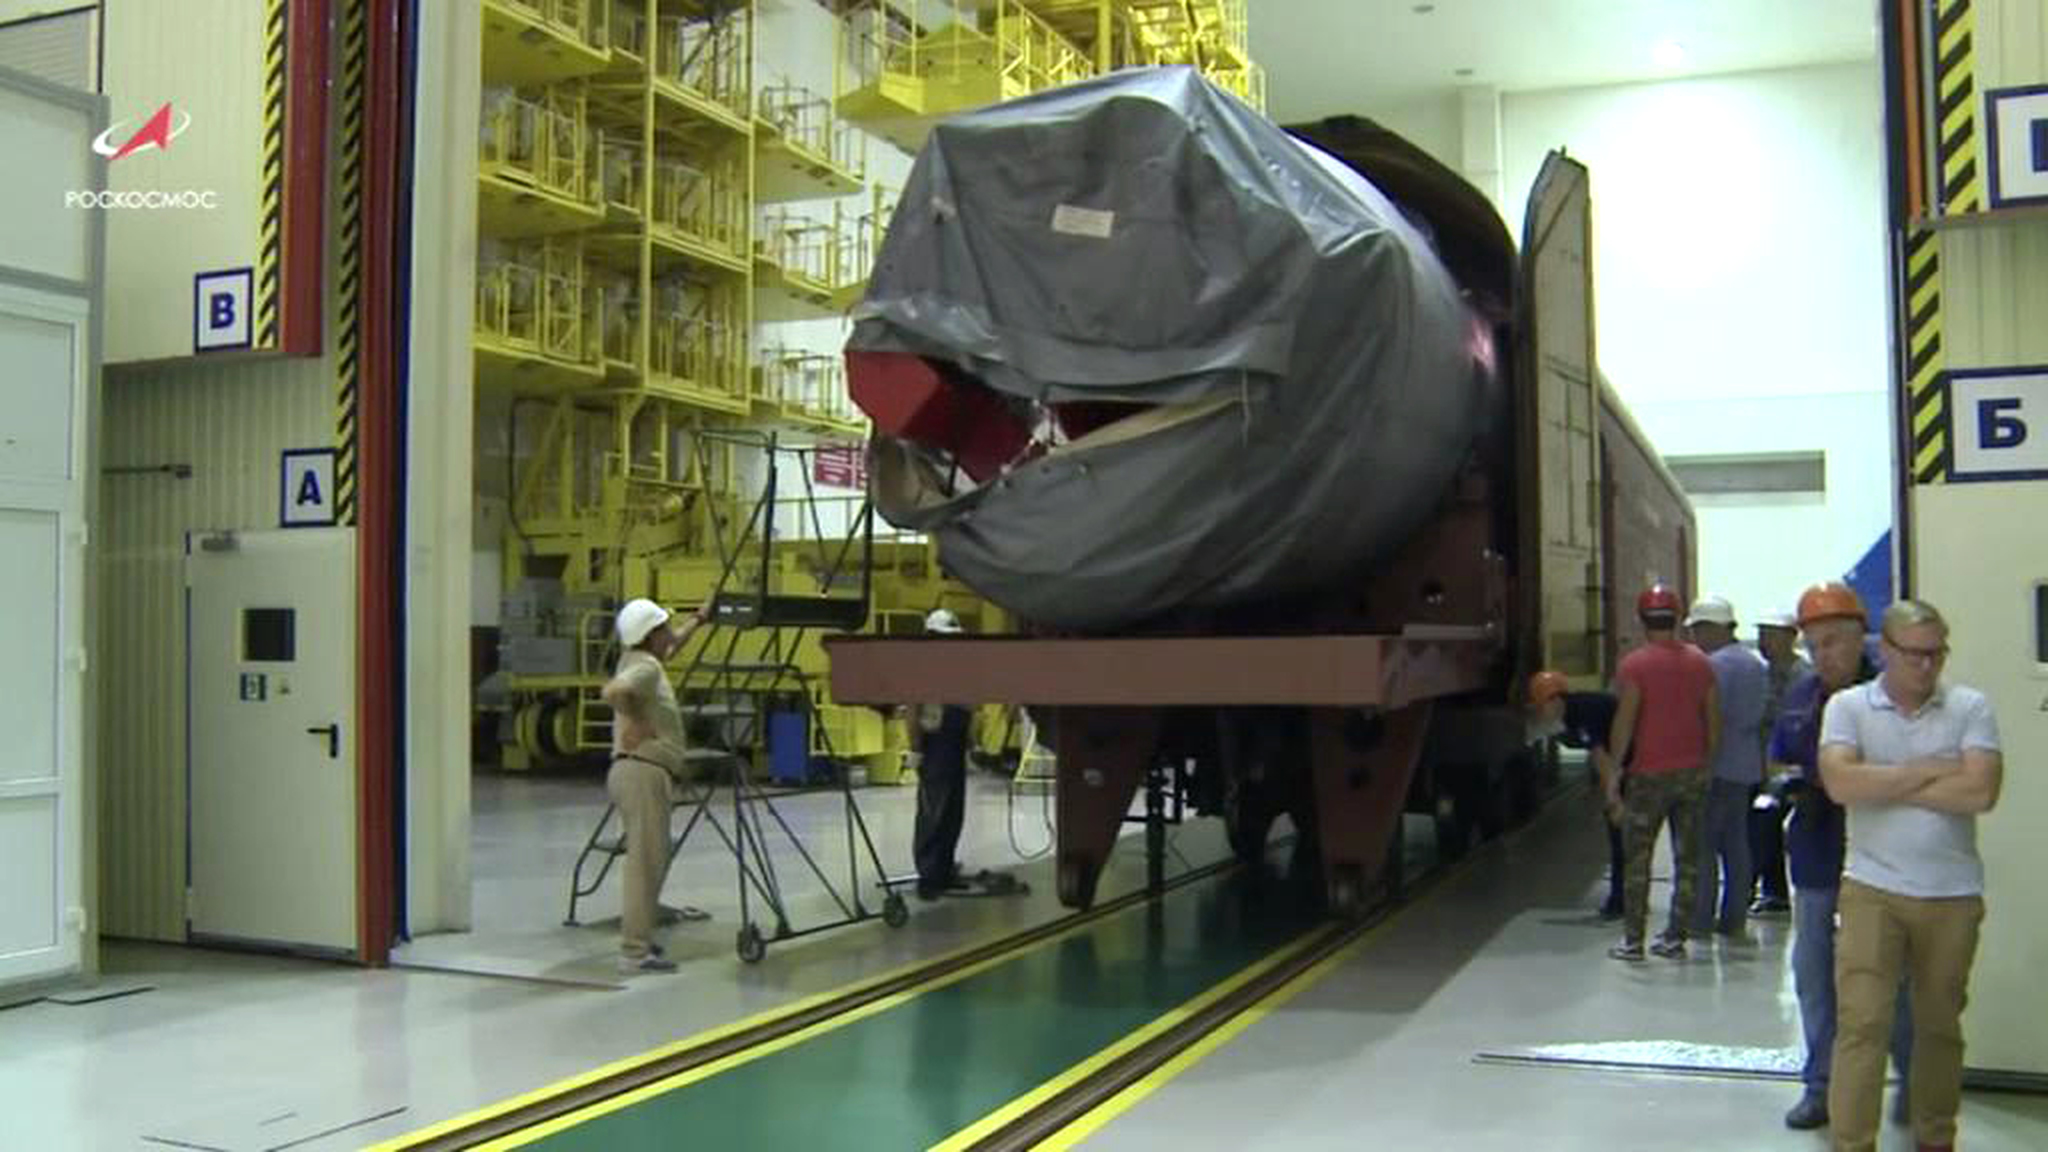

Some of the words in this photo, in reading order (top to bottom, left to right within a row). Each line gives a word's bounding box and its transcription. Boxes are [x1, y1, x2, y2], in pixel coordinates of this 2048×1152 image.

[210, 292, 235, 330] В
[1977, 397, 2028, 450] Б
[296, 469, 323, 506] А
